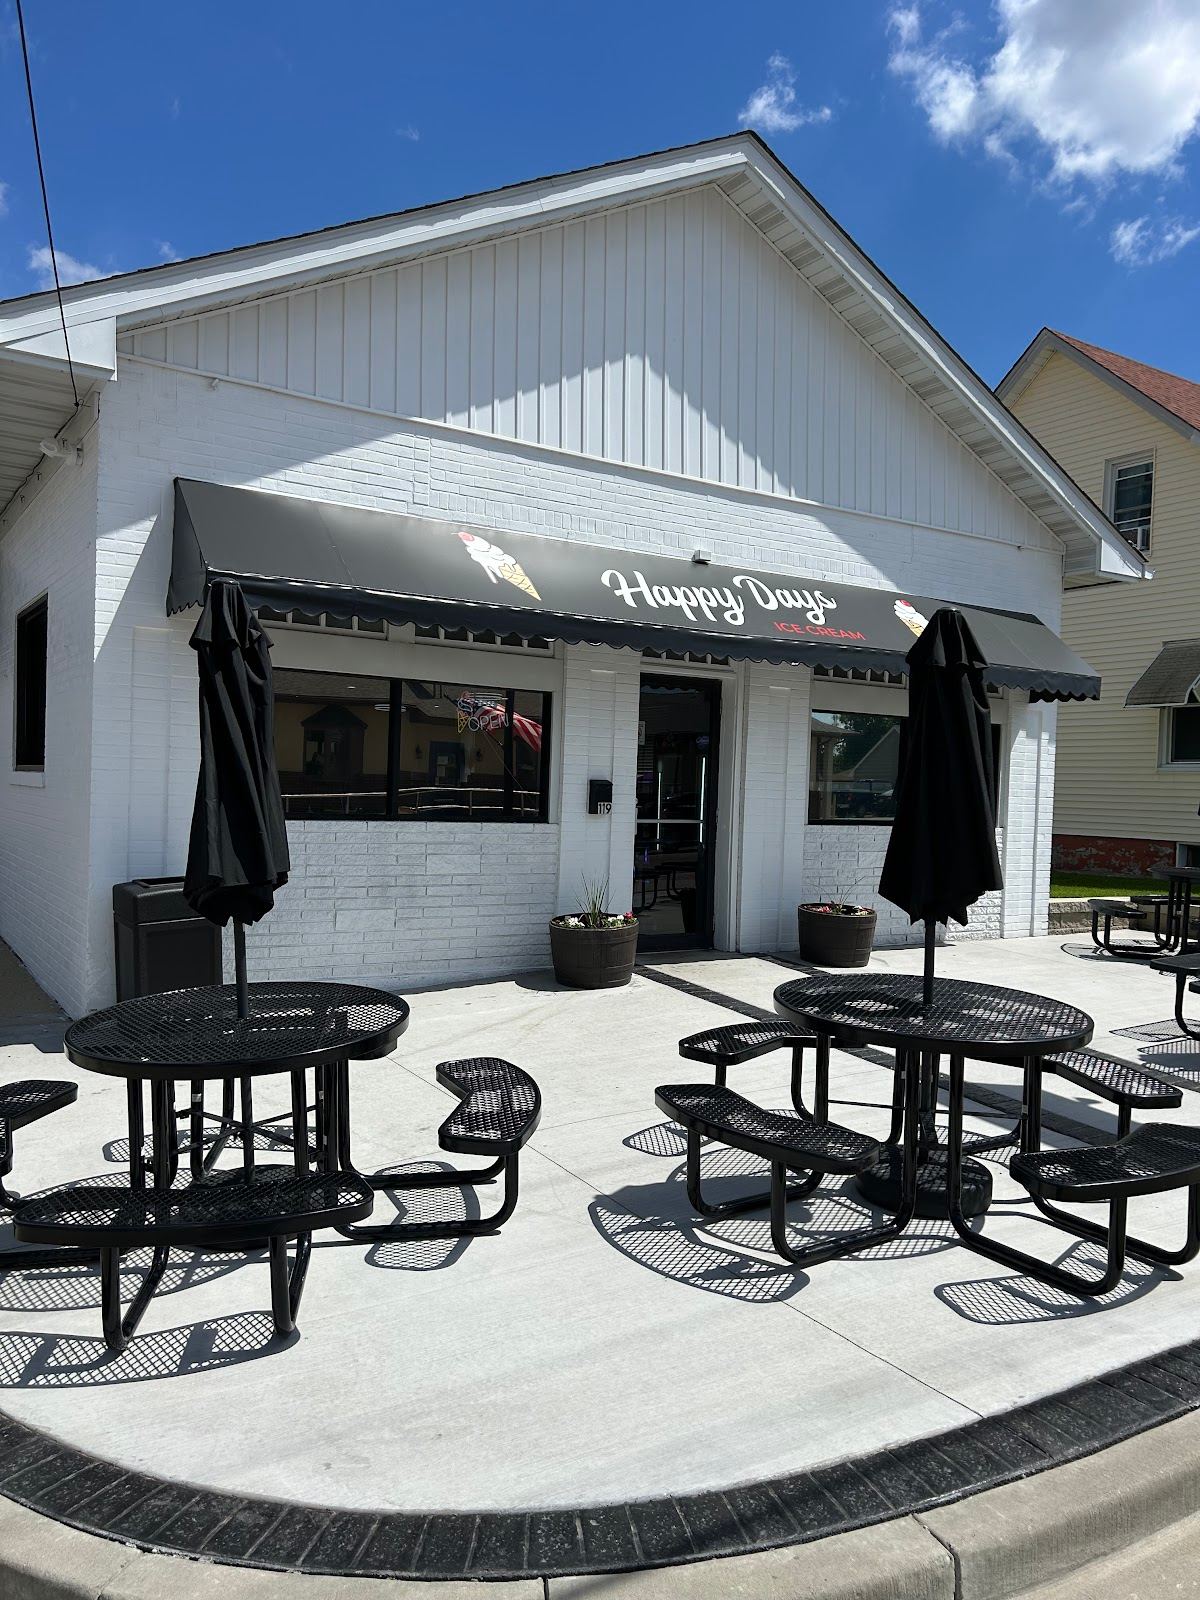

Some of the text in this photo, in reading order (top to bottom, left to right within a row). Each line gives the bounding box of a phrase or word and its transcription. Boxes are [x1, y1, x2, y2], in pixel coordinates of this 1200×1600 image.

[601, 570, 837, 625] Happy Days
[774, 622, 866, 640] ICE CREAM
[468, 712, 509, 731] OPEN
[598, 803, 612, 814] 119
